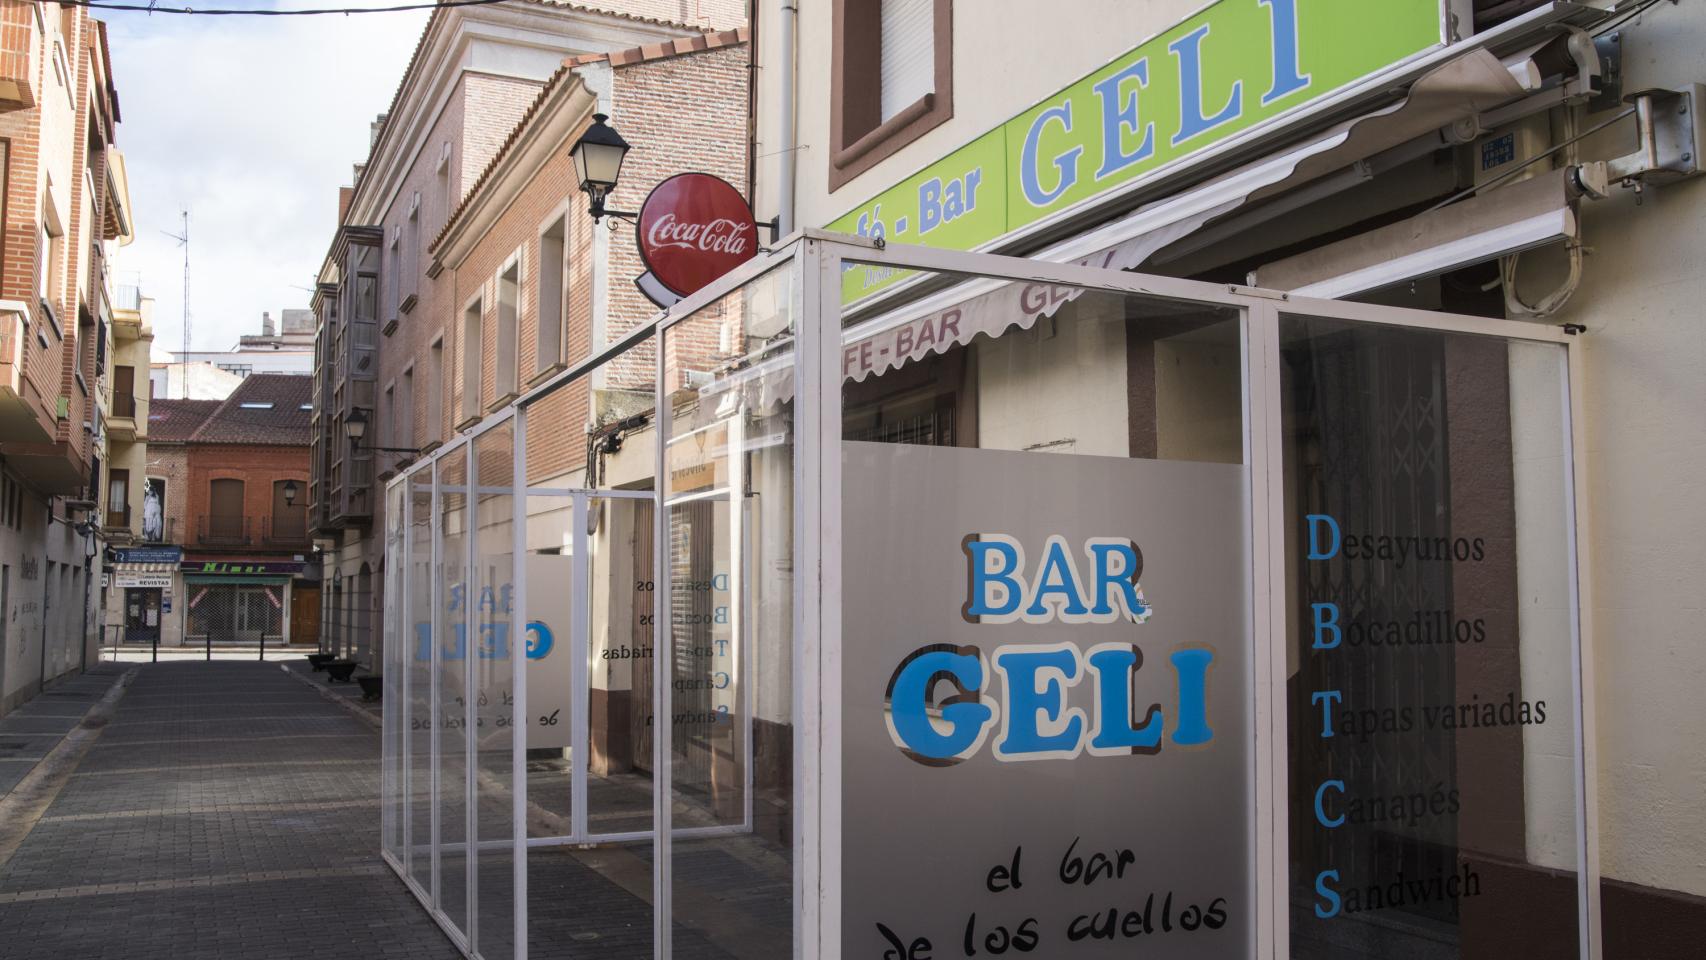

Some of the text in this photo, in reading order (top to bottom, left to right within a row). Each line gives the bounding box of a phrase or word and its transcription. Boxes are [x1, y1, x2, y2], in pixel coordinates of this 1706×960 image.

[918, 166, 982, 236] Bar
[1020, 0, 1311, 207] GELI
[648, 213, 749, 254] Coca-Cola
[1306, 514, 1485, 568] Desayunos
[962, 533, 1150, 624] BAR
[1311, 603, 1486, 649] Bocadillos
[886, 643, 1216, 766] GELI
[1312, 691, 1547, 742] Tapas variadas
[1314, 779, 1460, 828] Canapés
[987, 837, 1135, 892] el bar
[1315, 862, 1481, 919] Sandwich
[876, 891, 1227, 960] de los cuellos
